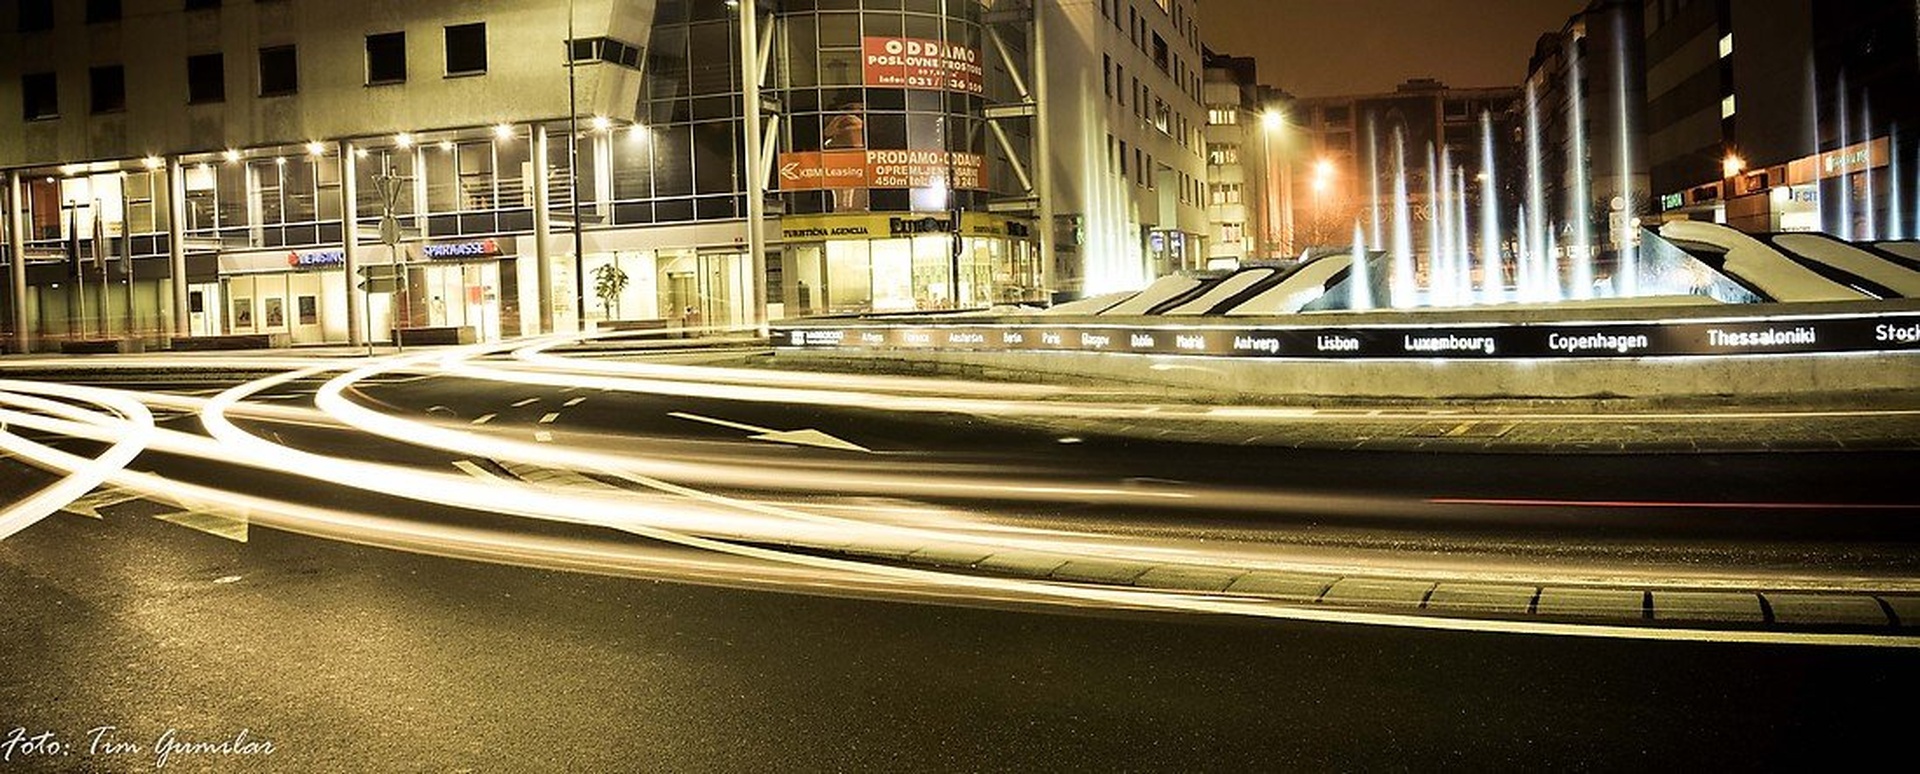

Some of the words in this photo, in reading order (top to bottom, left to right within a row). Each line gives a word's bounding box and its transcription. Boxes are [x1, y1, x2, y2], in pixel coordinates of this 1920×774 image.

[868, 55, 939, 67] POSLOVNE
[885, 40, 975, 63] ODDAMO
[1233, 335, 1279, 354] Antwerp
[1317, 335, 1359, 351] Lisbon
[1404, 335, 1495, 354] Luxembourg
[1549, 333, 1648, 353] Copenhagen
[1706, 327, 1816, 346] Thessaloniki
